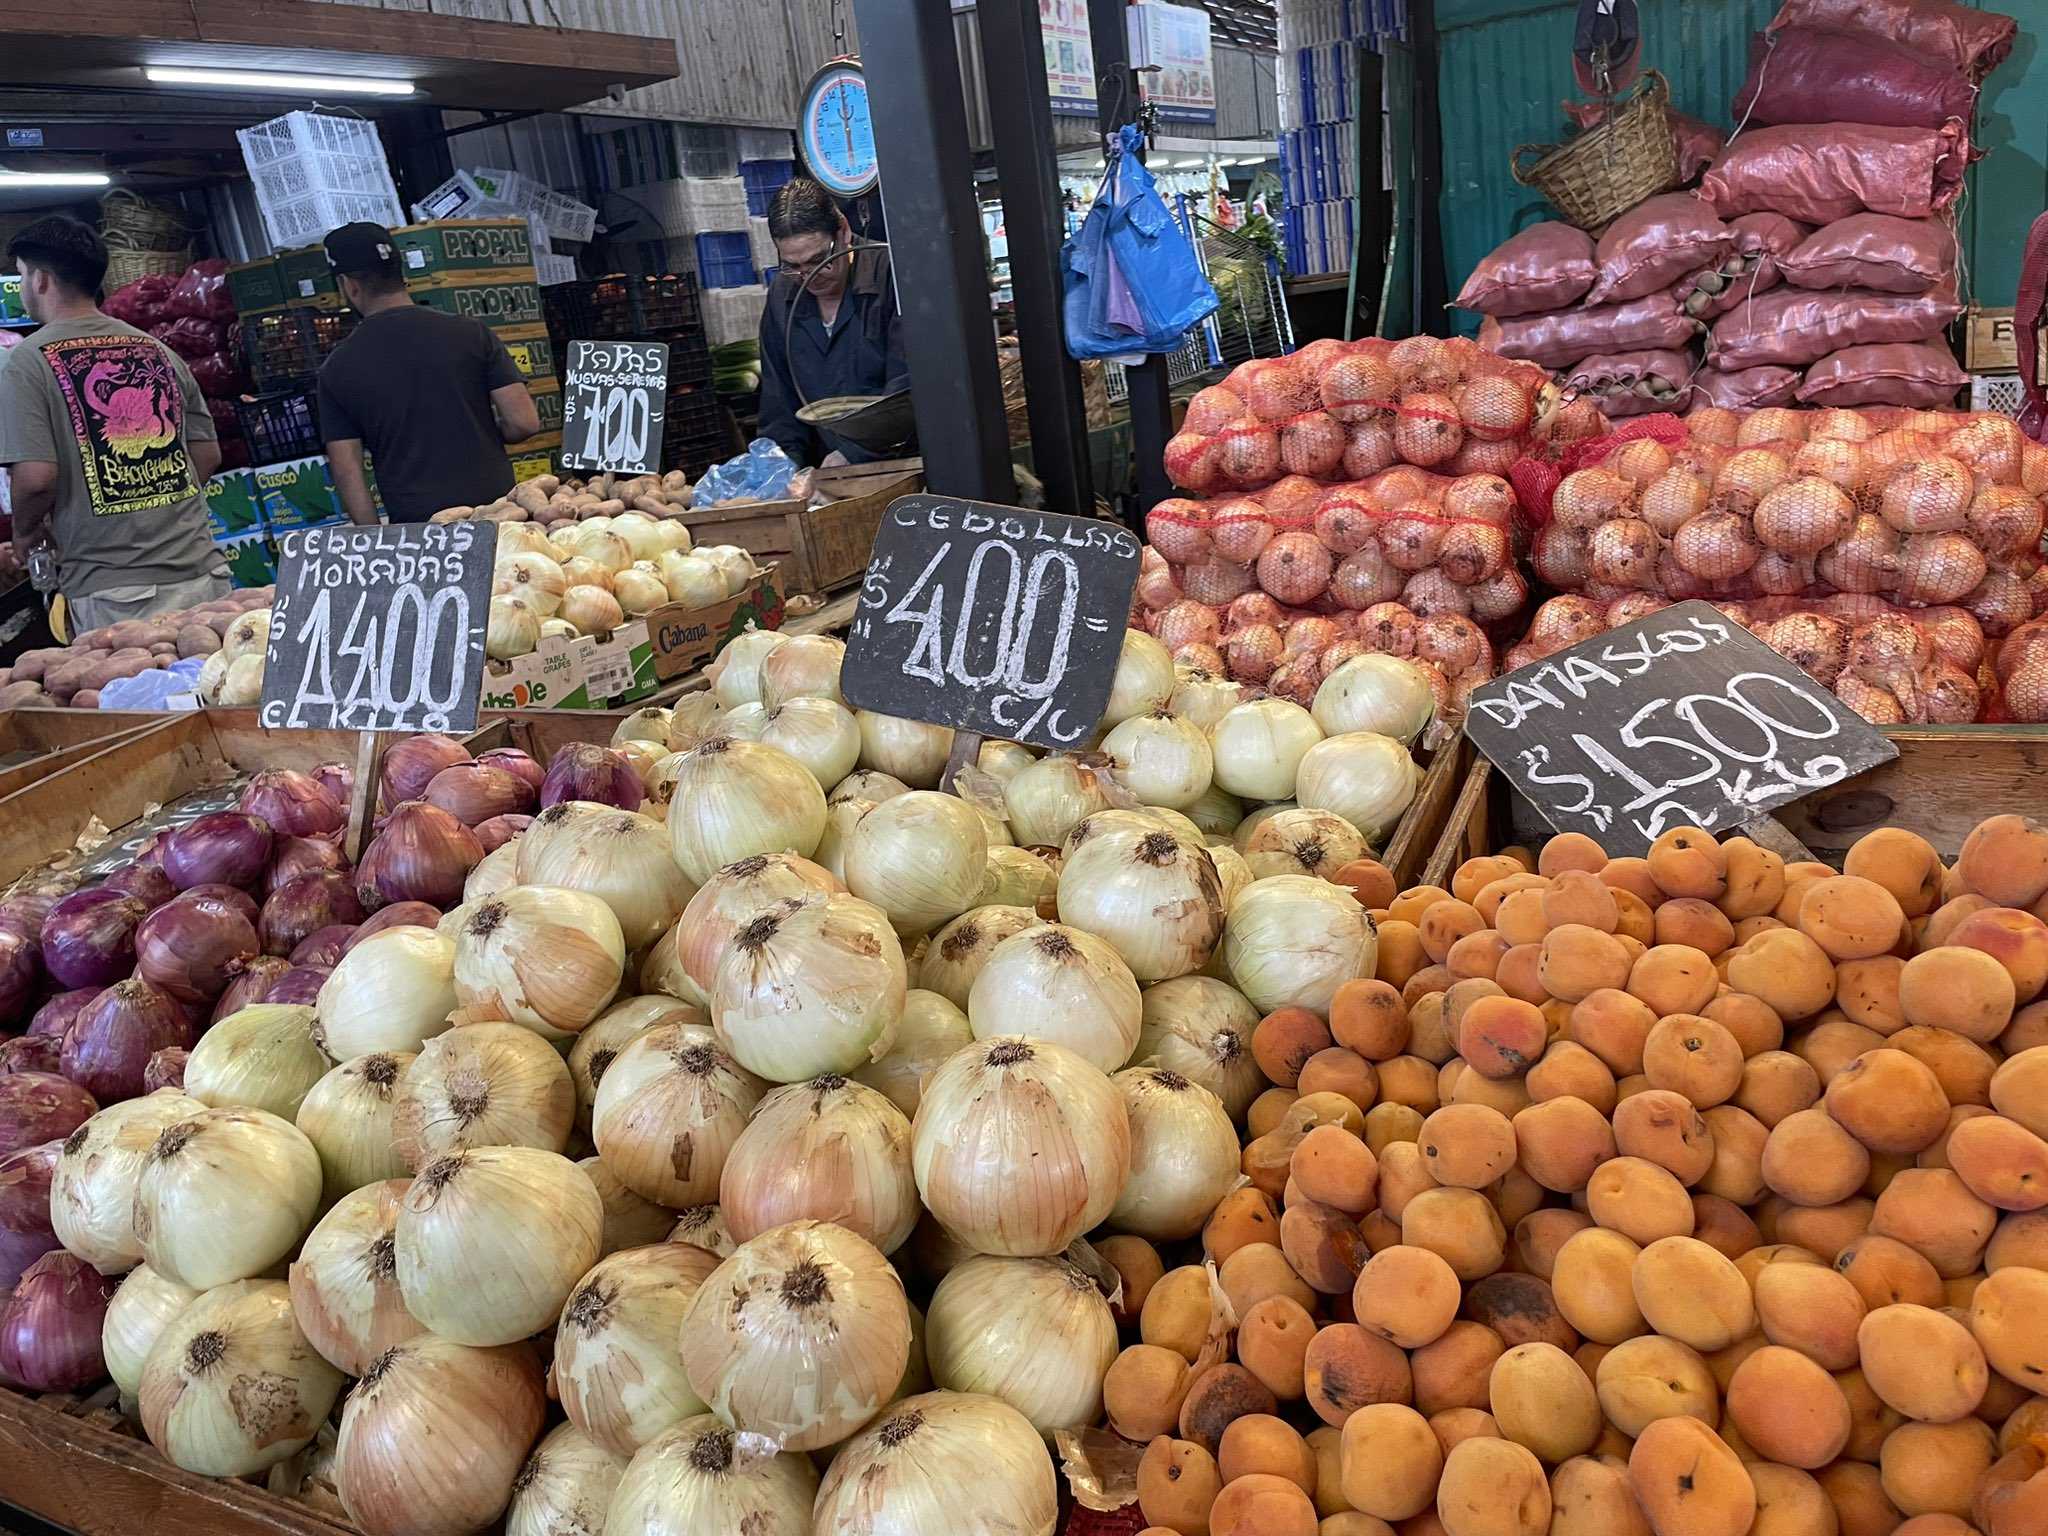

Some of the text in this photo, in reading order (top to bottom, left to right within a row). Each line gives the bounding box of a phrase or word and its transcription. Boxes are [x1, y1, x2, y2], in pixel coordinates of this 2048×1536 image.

[442, 228, 529, 259] PROPAL
[454, 286, 541, 317] PROPAL
[577, 342, 662, 373] PAPAS
[562, 452, 585, 470] EL
[659, 623, 709, 653] Cabana
[543, 660, 572, 674] GRAPES
[545, 653, 568, 666] TABLE
[261, 699, 308, 729] EL
